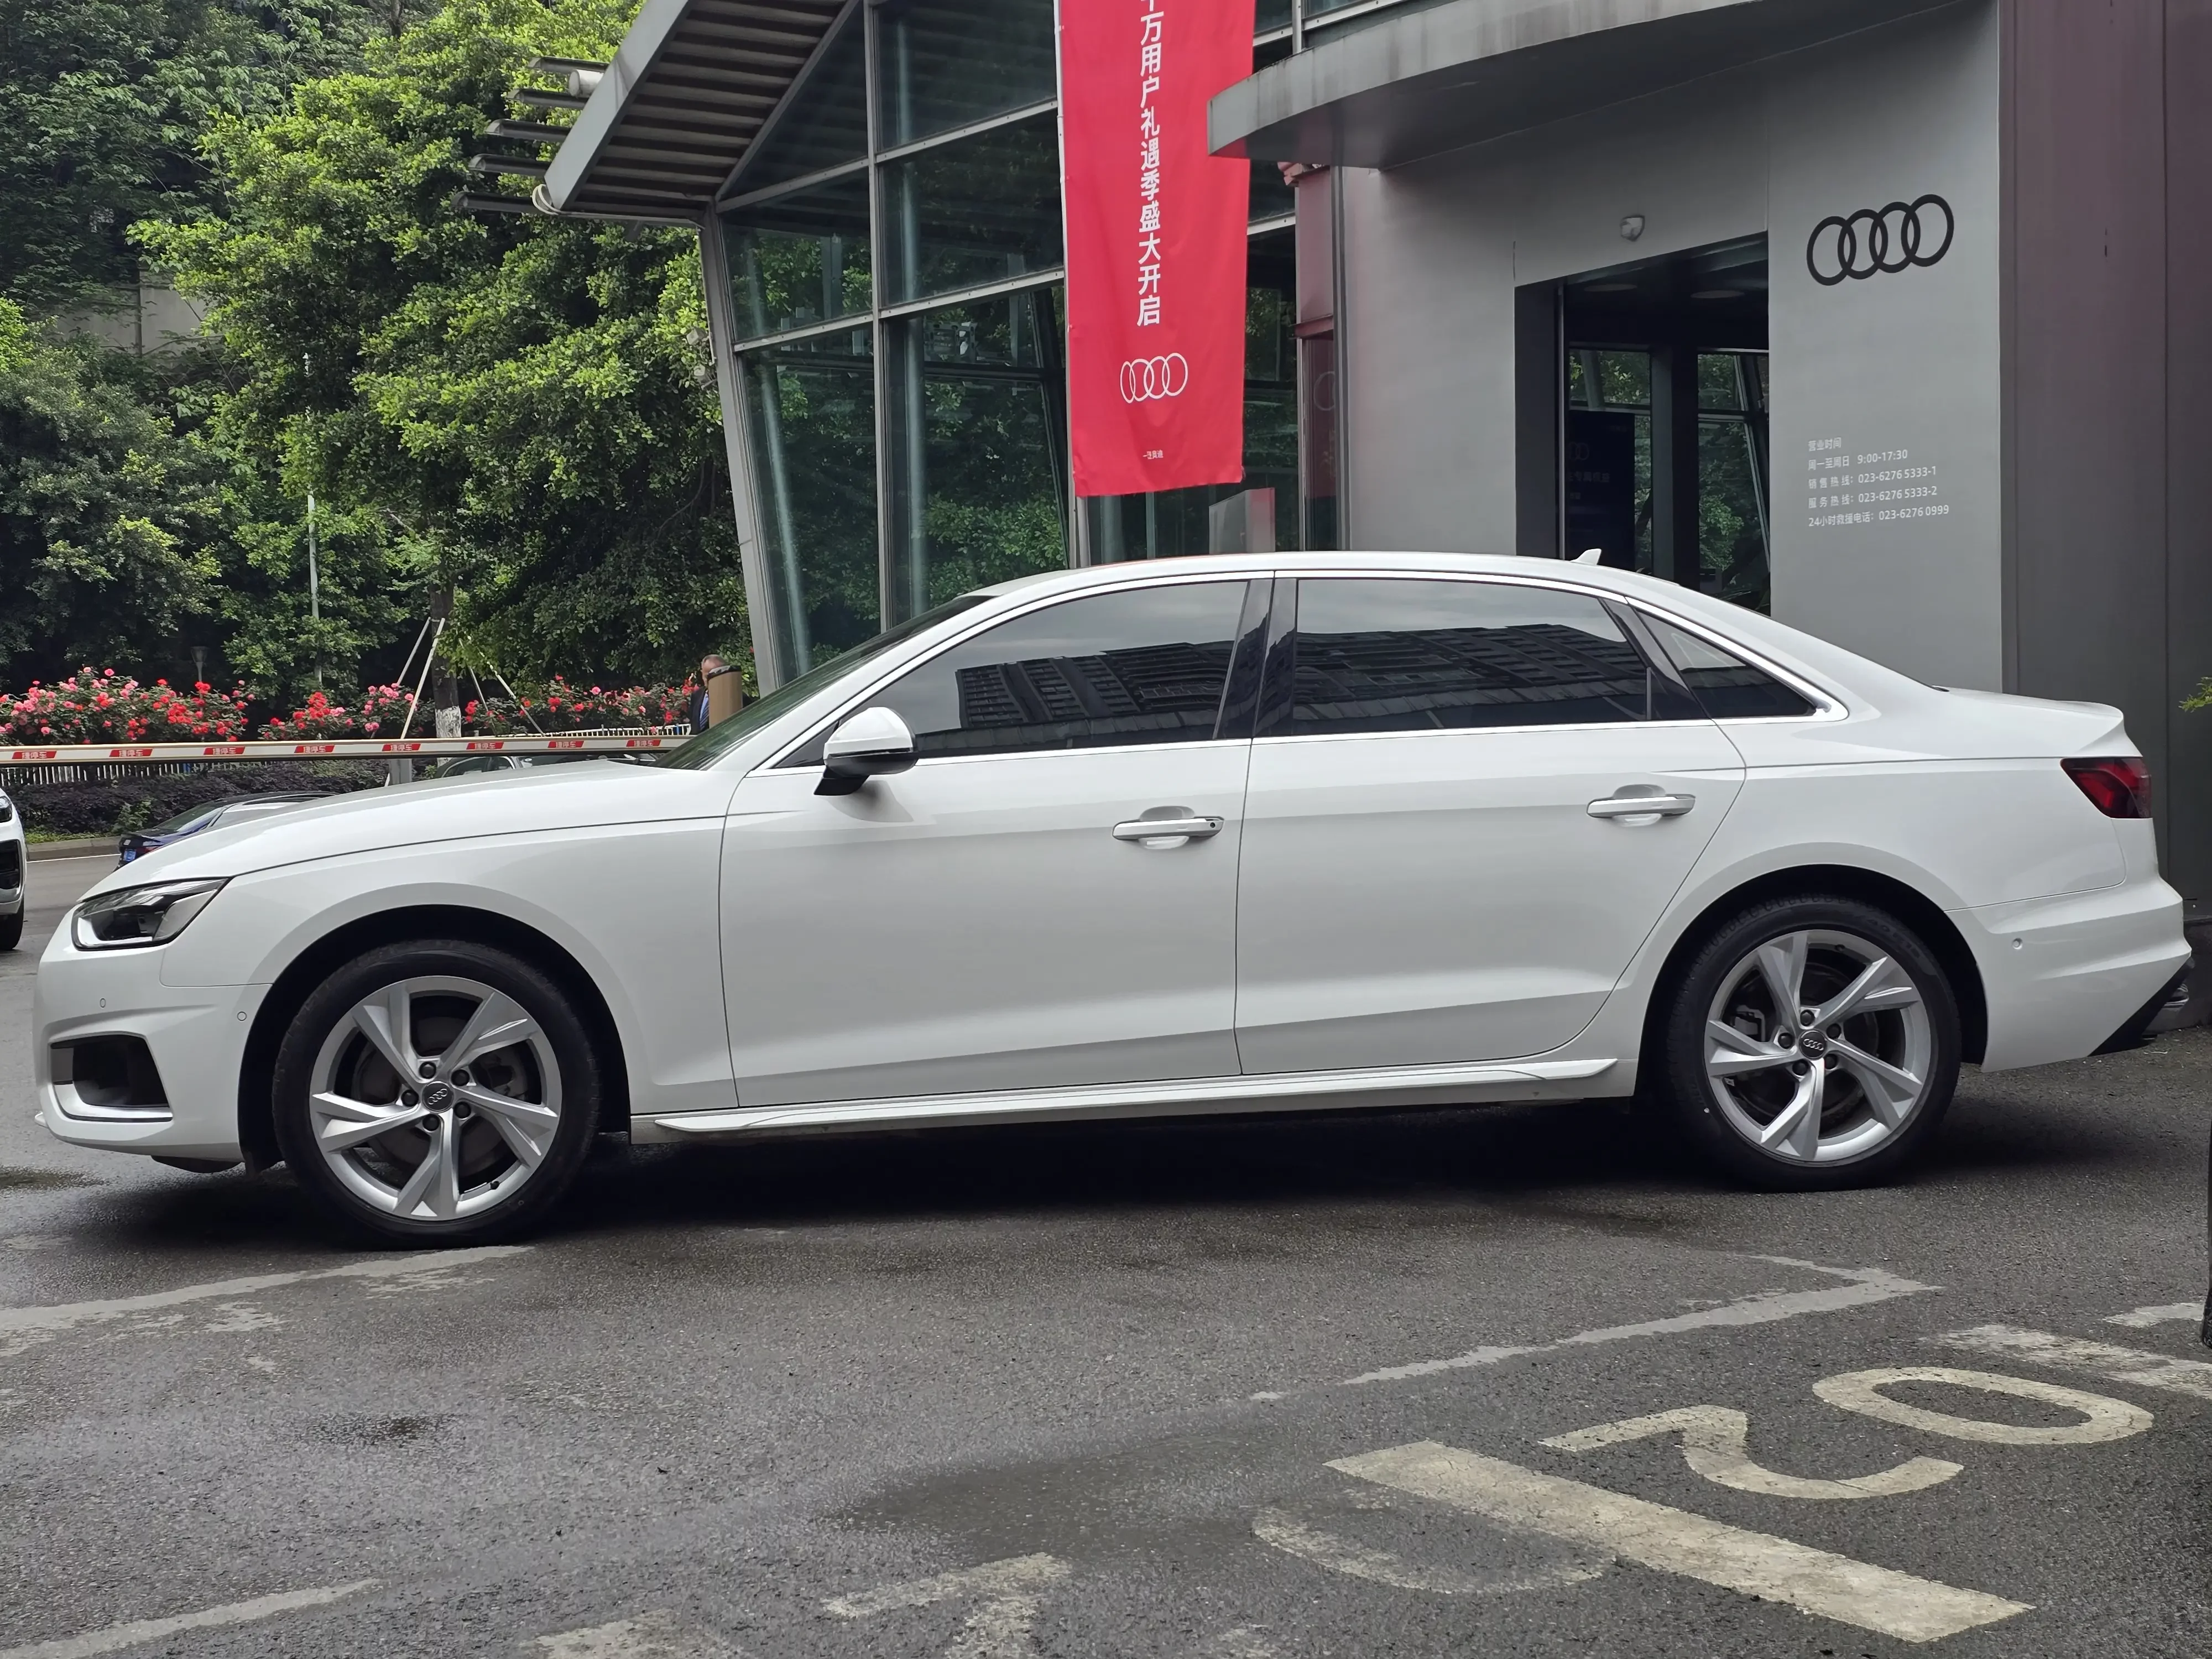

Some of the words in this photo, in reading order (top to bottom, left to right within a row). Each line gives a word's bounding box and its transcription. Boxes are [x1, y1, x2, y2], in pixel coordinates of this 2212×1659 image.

[1808, 455, 1849, 471] 周一至周日
[1857, 449, 1908, 464] 9:00-17:30
[1858, 469, 1902, 483] 023-6276
[1904, 466, 1936, 479] 5333-1
[1858, 489, 1902, 503] 023-6276
[1904, 486, 1937, 498] 5333-2
[1879, 508, 1923, 520] 023-6276
[1925, 504, 1949, 516] 0999
